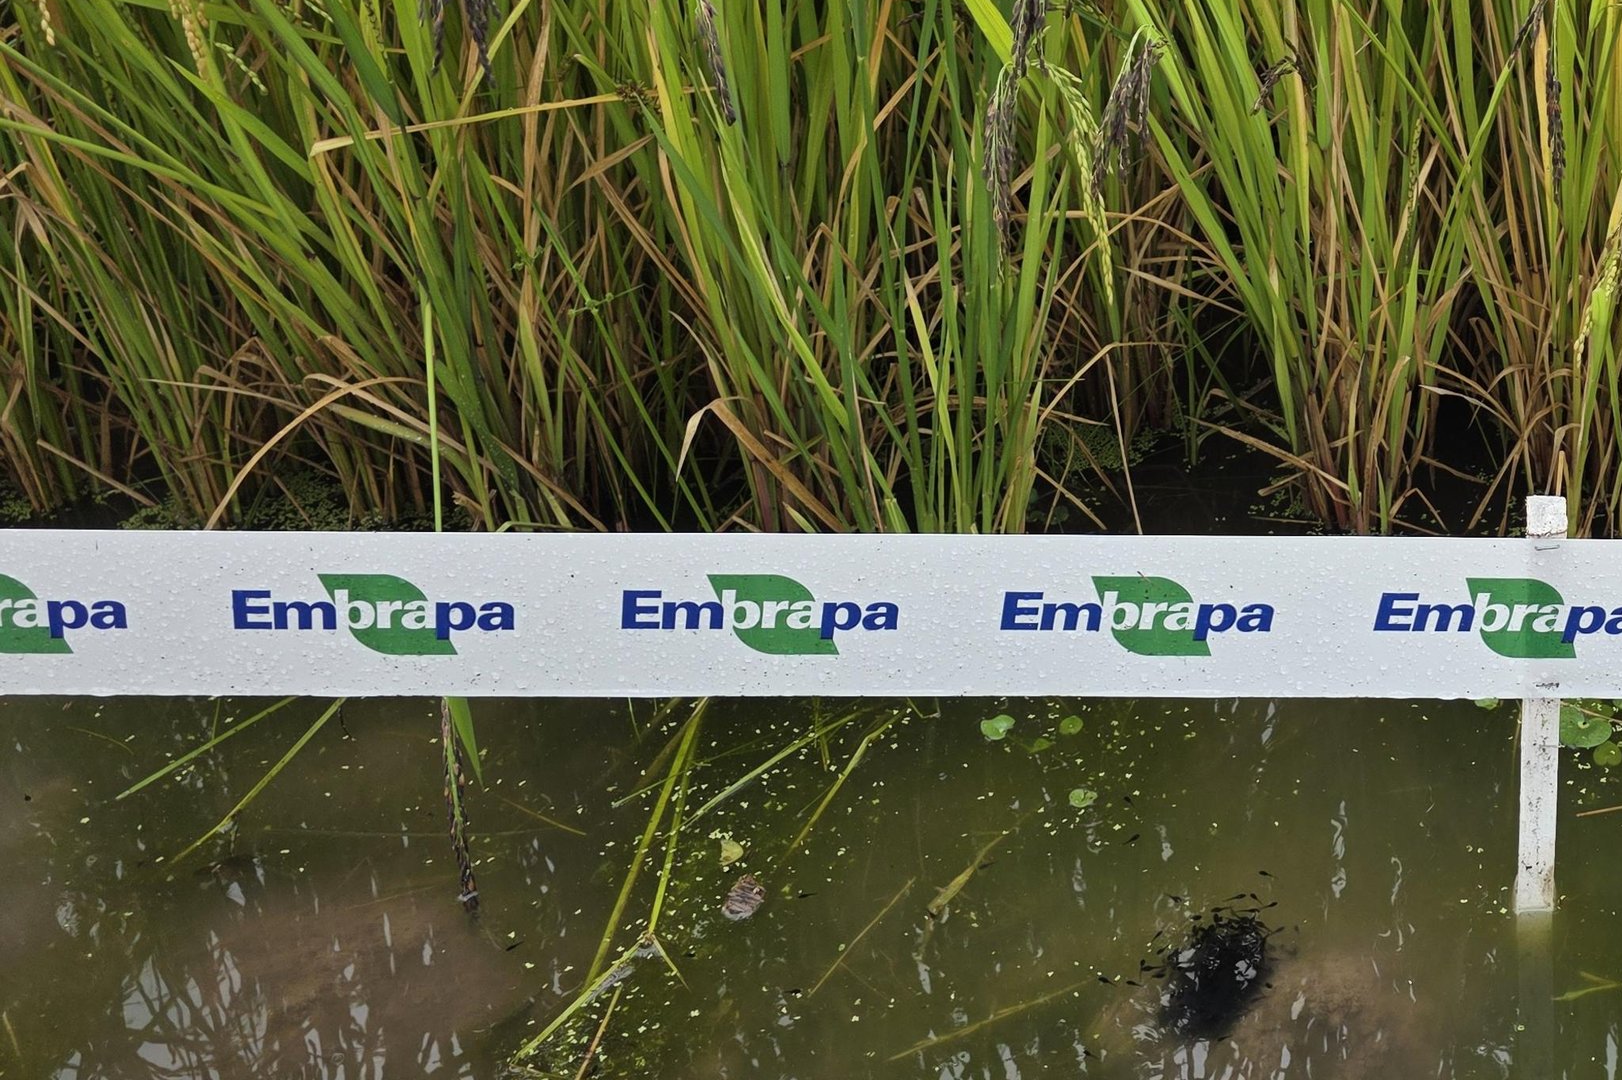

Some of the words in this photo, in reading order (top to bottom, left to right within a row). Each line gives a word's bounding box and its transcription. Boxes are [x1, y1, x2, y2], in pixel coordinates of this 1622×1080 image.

[232, 589, 514, 639] Embrapa
[621, 589, 899, 639] Embrapa
[1000, 591, 1274, 640] Embrapa
